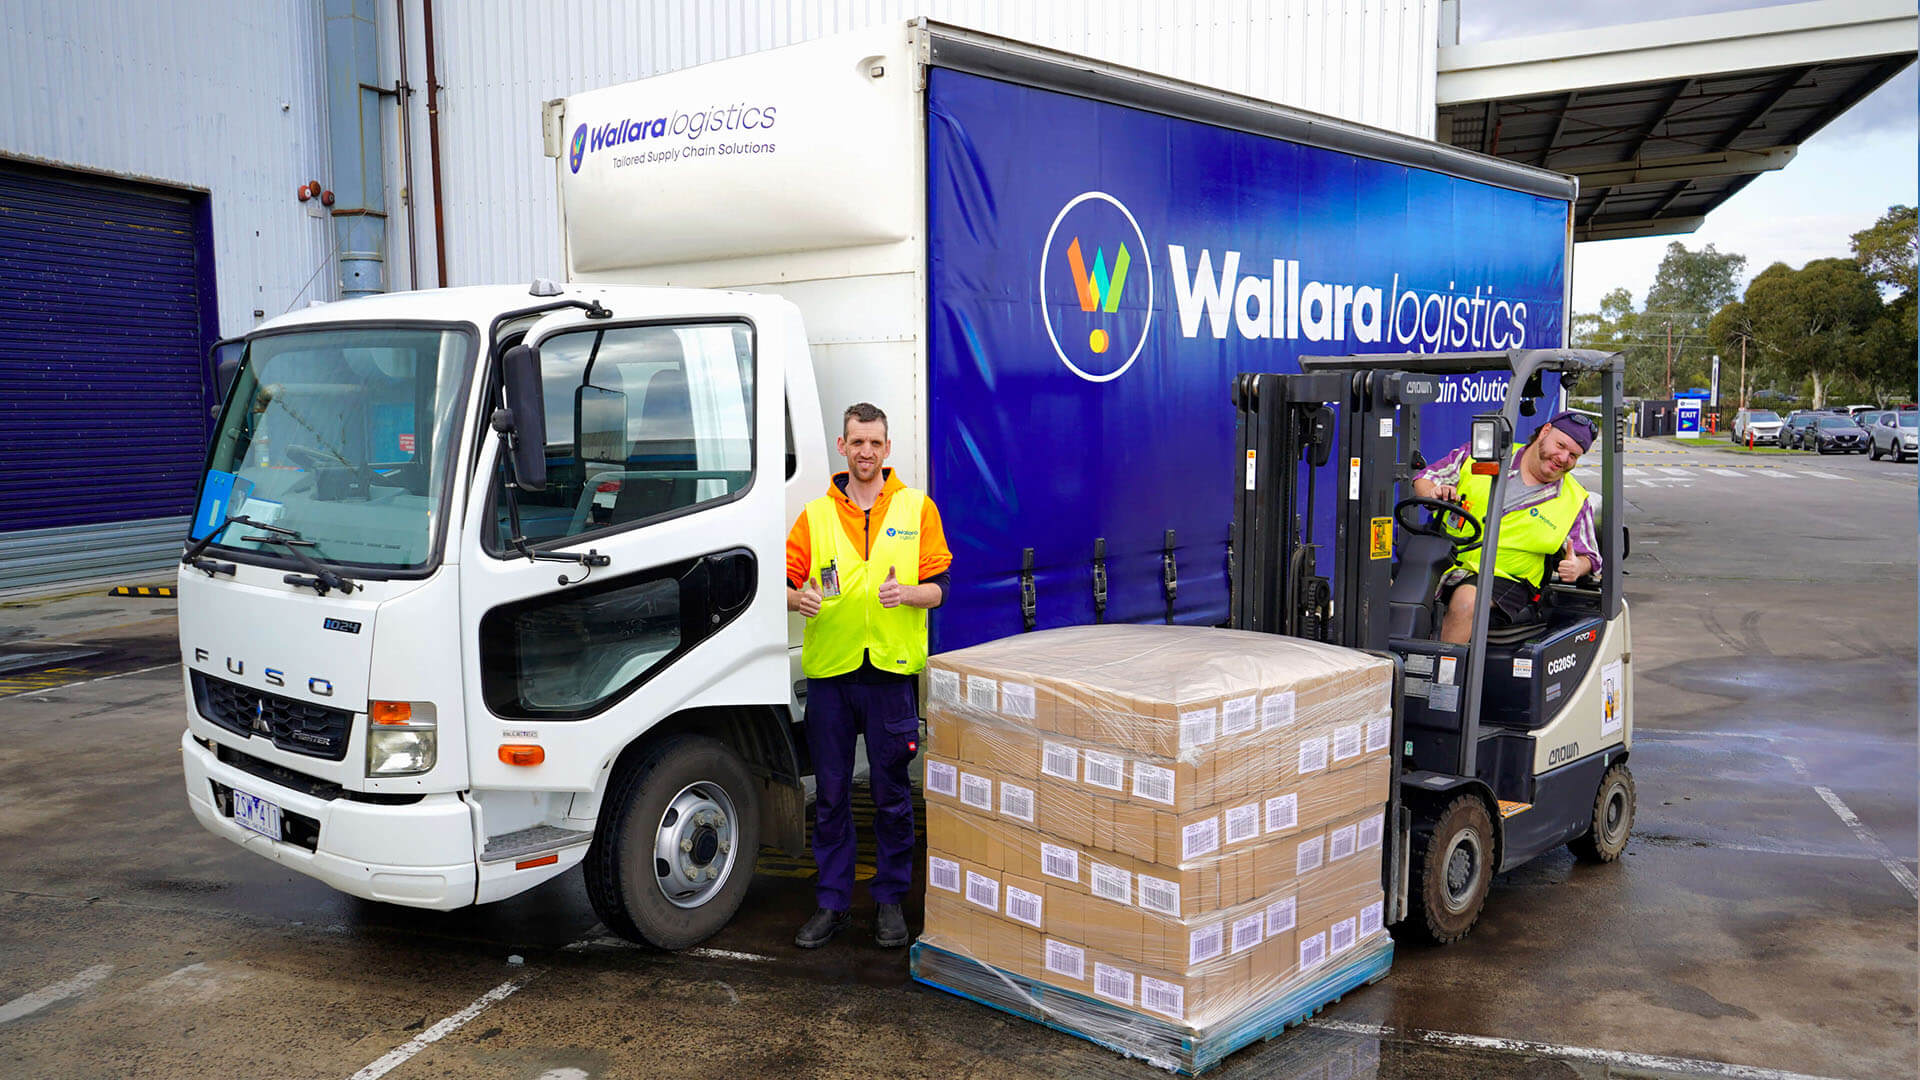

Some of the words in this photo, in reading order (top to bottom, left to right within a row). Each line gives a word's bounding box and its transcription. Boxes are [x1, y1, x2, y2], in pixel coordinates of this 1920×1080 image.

[590, 118, 667, 152] Wallara
[668, 102, 777, 140] logistics
[613, 152, 646, 168] Tailored
[647, 148, 680, 163] Supply
[682, 144, 715, 158] Chain
[718, 142, 776, 155] Solutions
[1168, 244, 1383, 342] Wallara
[1387, 273, 1527, 354] logistics
[326, 619, 359, 633] 1024
[195, 647, 334, 697] FUSO
[1547, 653, 1577, 675] CG20SC
[1548, 741, 1580, 766] CROWN
